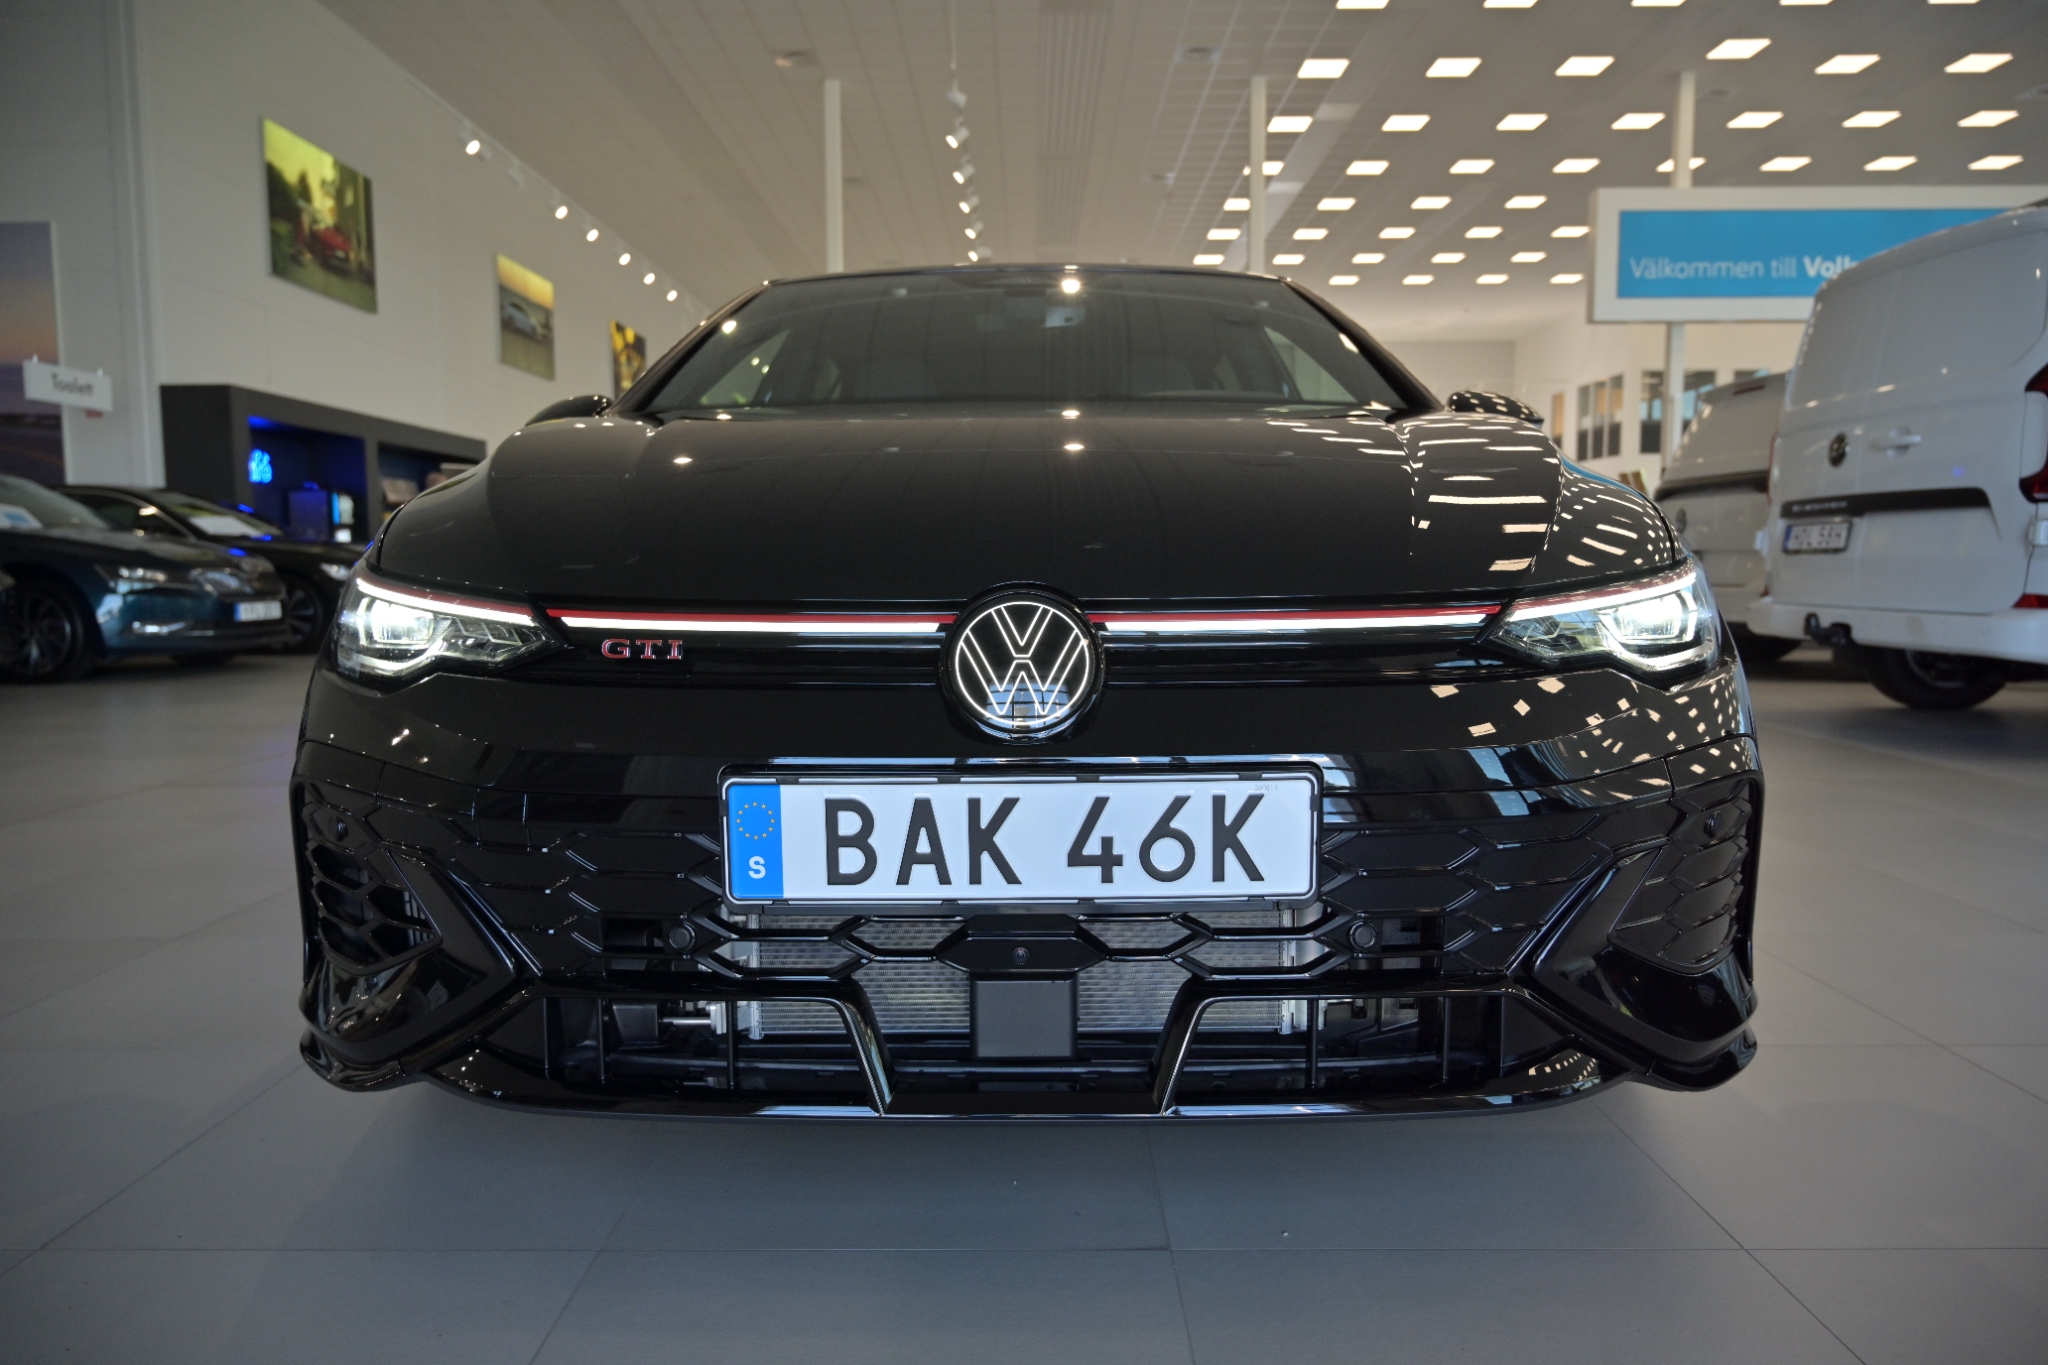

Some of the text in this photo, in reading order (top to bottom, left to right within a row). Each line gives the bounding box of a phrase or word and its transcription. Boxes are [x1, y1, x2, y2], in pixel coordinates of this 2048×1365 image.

[1629, 256, 1765, 279] Välkommen
[1770, 255, 1798, 279] till
[601, 638, 683, 660] GTI
[824, 794, 1265, 886] BAK 46K
[748, 856, 766, 879] S
